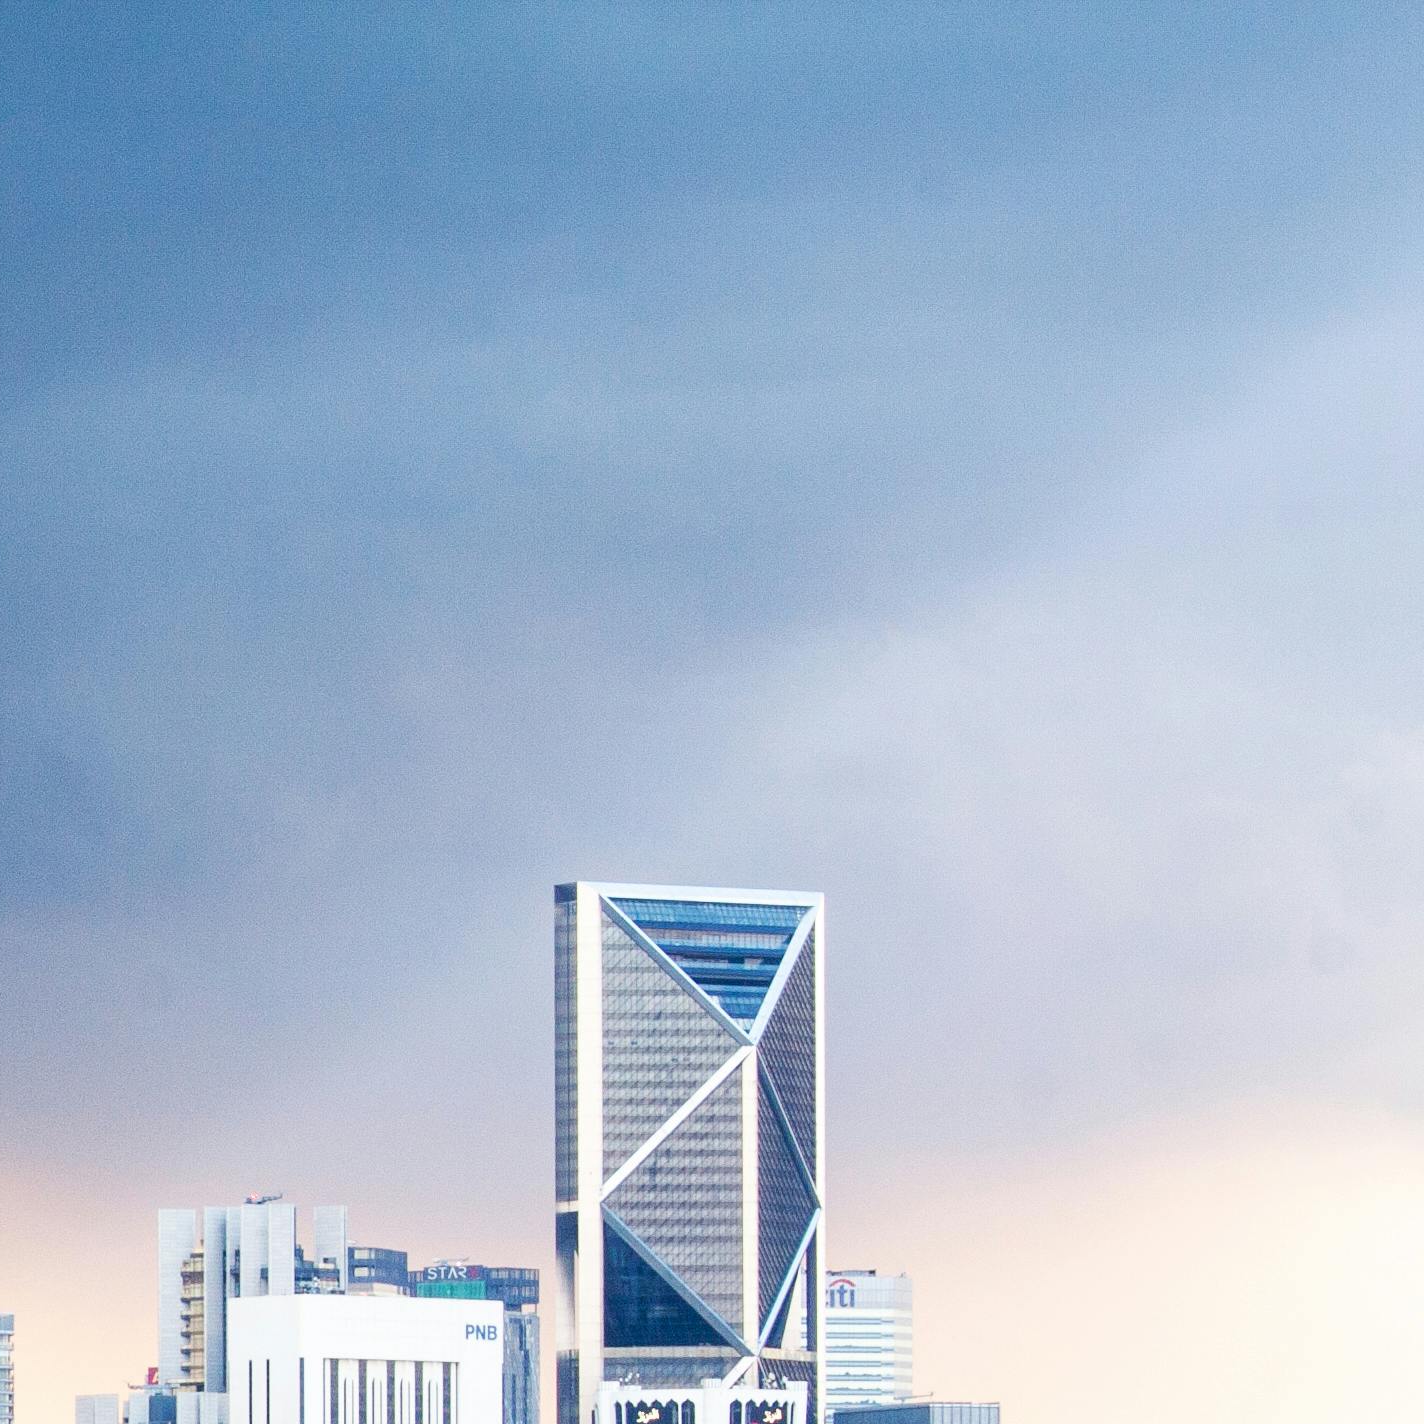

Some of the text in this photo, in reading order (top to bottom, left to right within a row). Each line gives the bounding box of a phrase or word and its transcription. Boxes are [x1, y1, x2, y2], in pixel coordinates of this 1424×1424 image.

[427, 1266, 467, 1280] STAR
[825, 1284, 855, 1307] iti
[465, 1324, 497, 1340] PNB
